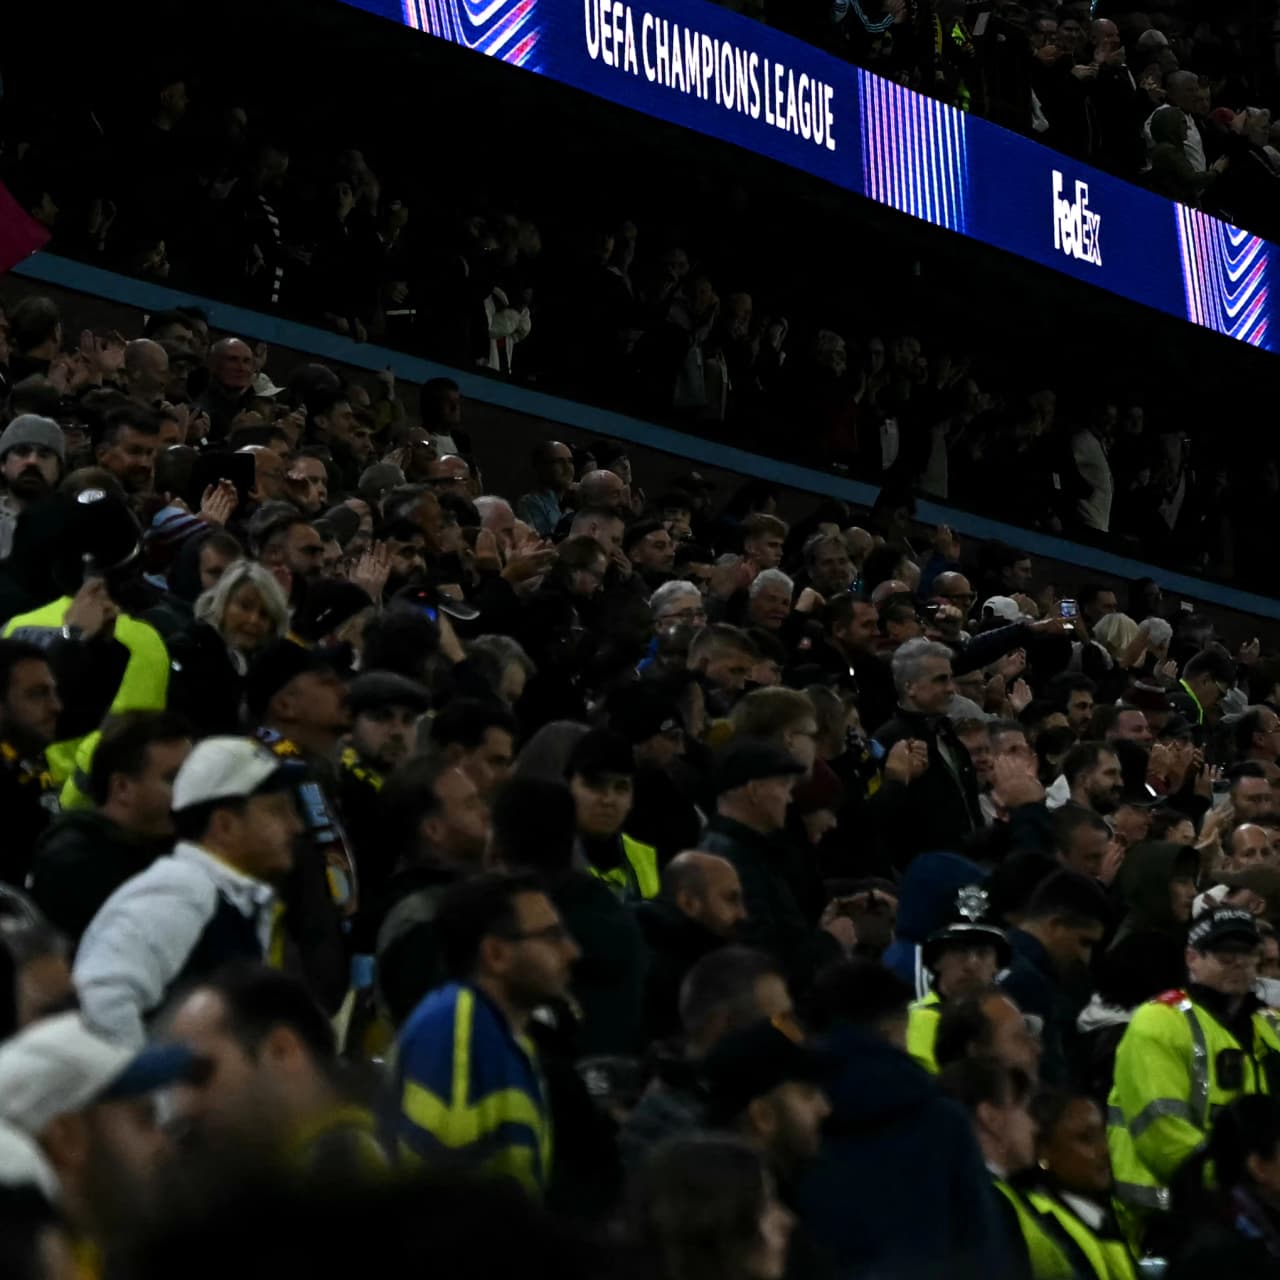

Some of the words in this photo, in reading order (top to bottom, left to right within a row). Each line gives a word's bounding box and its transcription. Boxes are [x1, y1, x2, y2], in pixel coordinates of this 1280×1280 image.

[642, 12, 761, 120] CHAMPIONS
[764, 58, 836, 151] LEAGUE
[1052, 169, 1102, 267] FedEx
